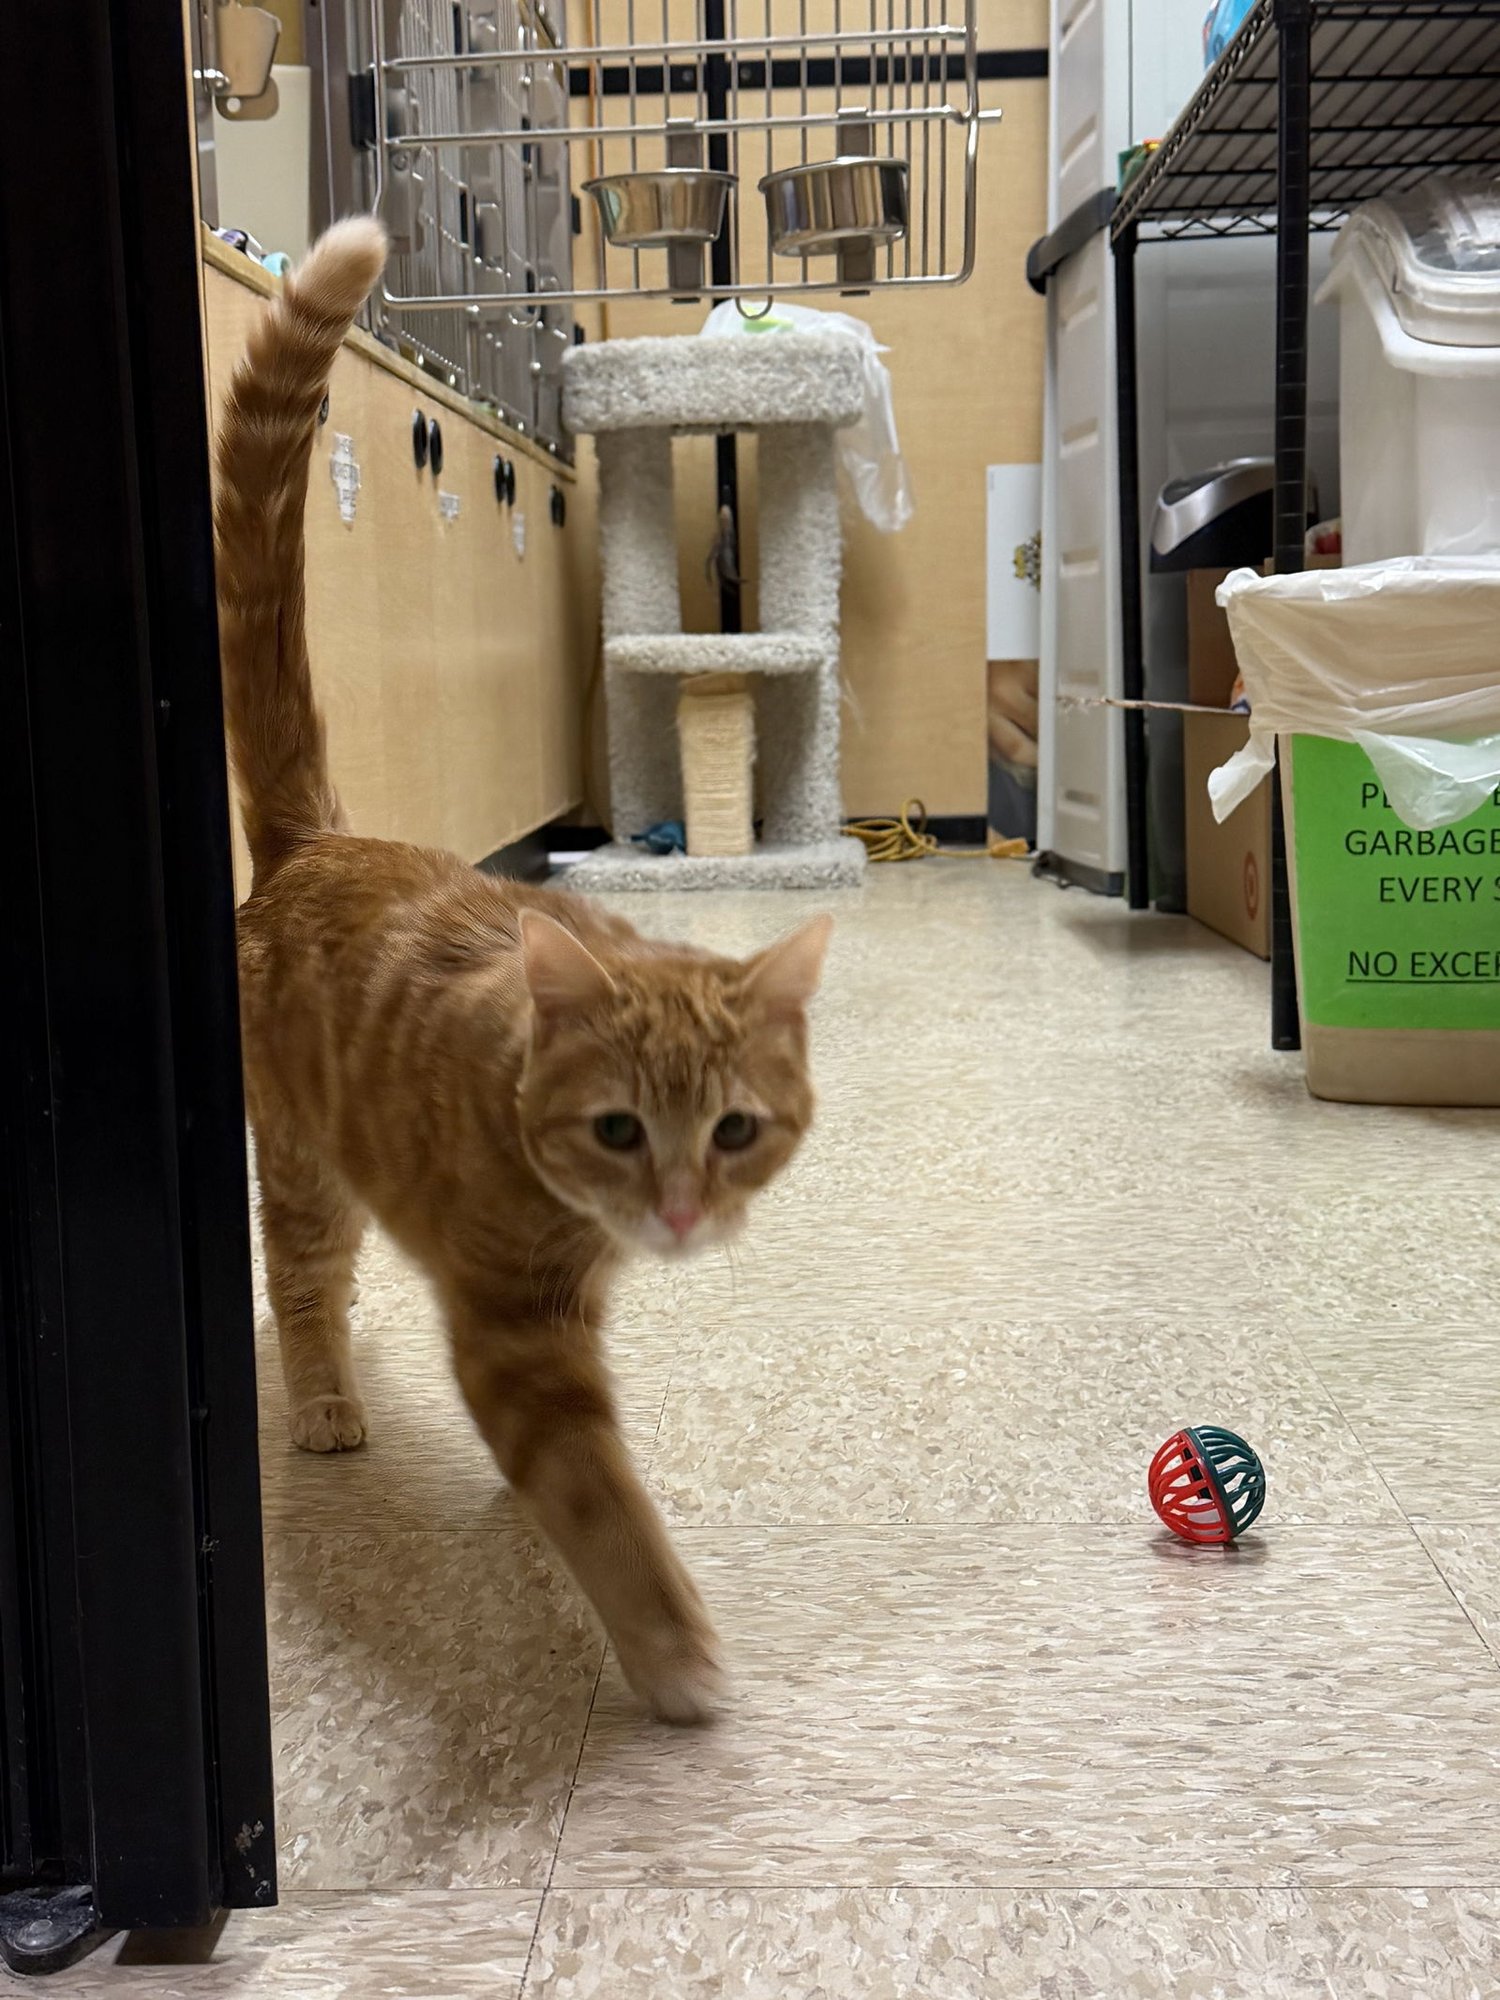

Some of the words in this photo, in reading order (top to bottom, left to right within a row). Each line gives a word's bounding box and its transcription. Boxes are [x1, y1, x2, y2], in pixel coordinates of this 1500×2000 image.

[1345, 828, 1500, 856] GARBAGE
[1380, 876, 1483, 903] EVERY
[1349, 951, 1398, 977] NO
